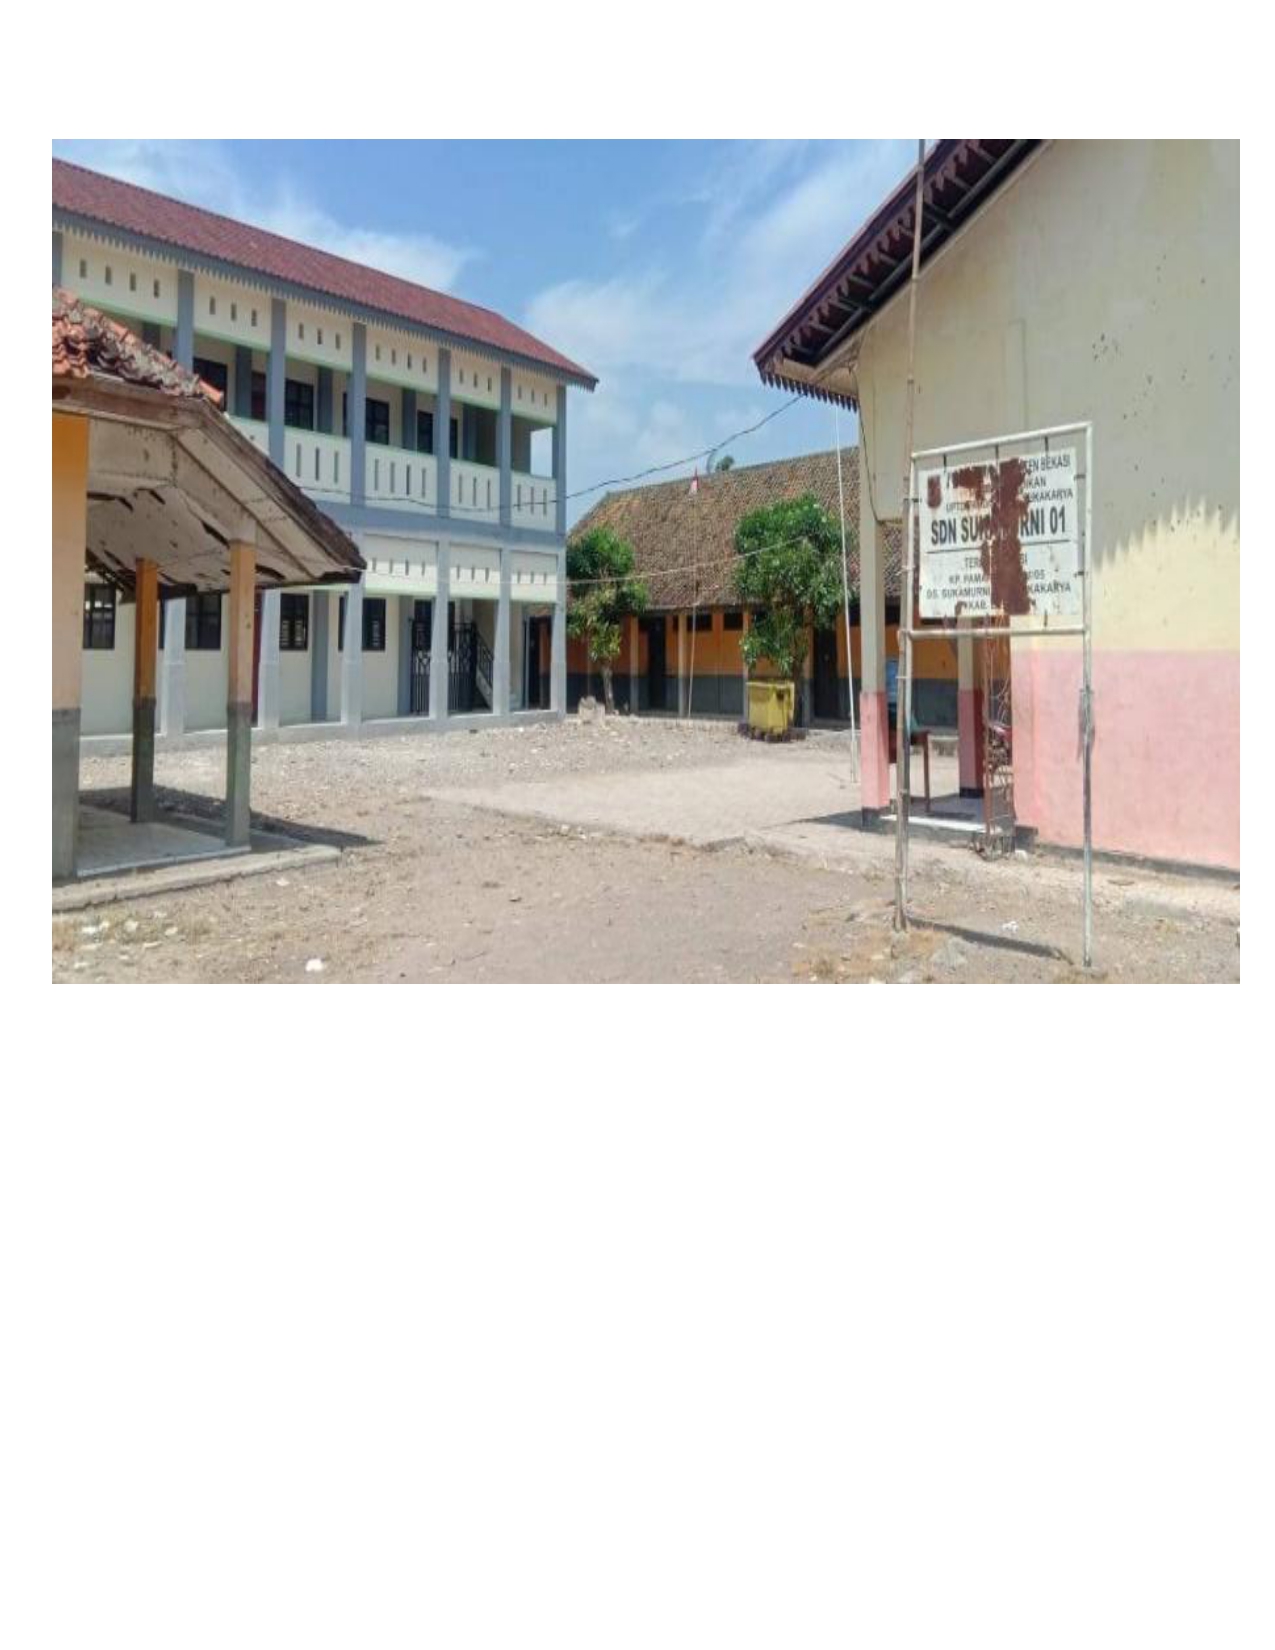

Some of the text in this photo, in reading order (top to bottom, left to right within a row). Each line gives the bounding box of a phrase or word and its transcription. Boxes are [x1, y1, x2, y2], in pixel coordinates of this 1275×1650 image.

[1040, 454, 1071, 471] BEKASI
[1026, 488, 1073, 502] UKAKARYA
[931, 518, 957, 546] SDN
[1049, 504, 1066, 534] 01
